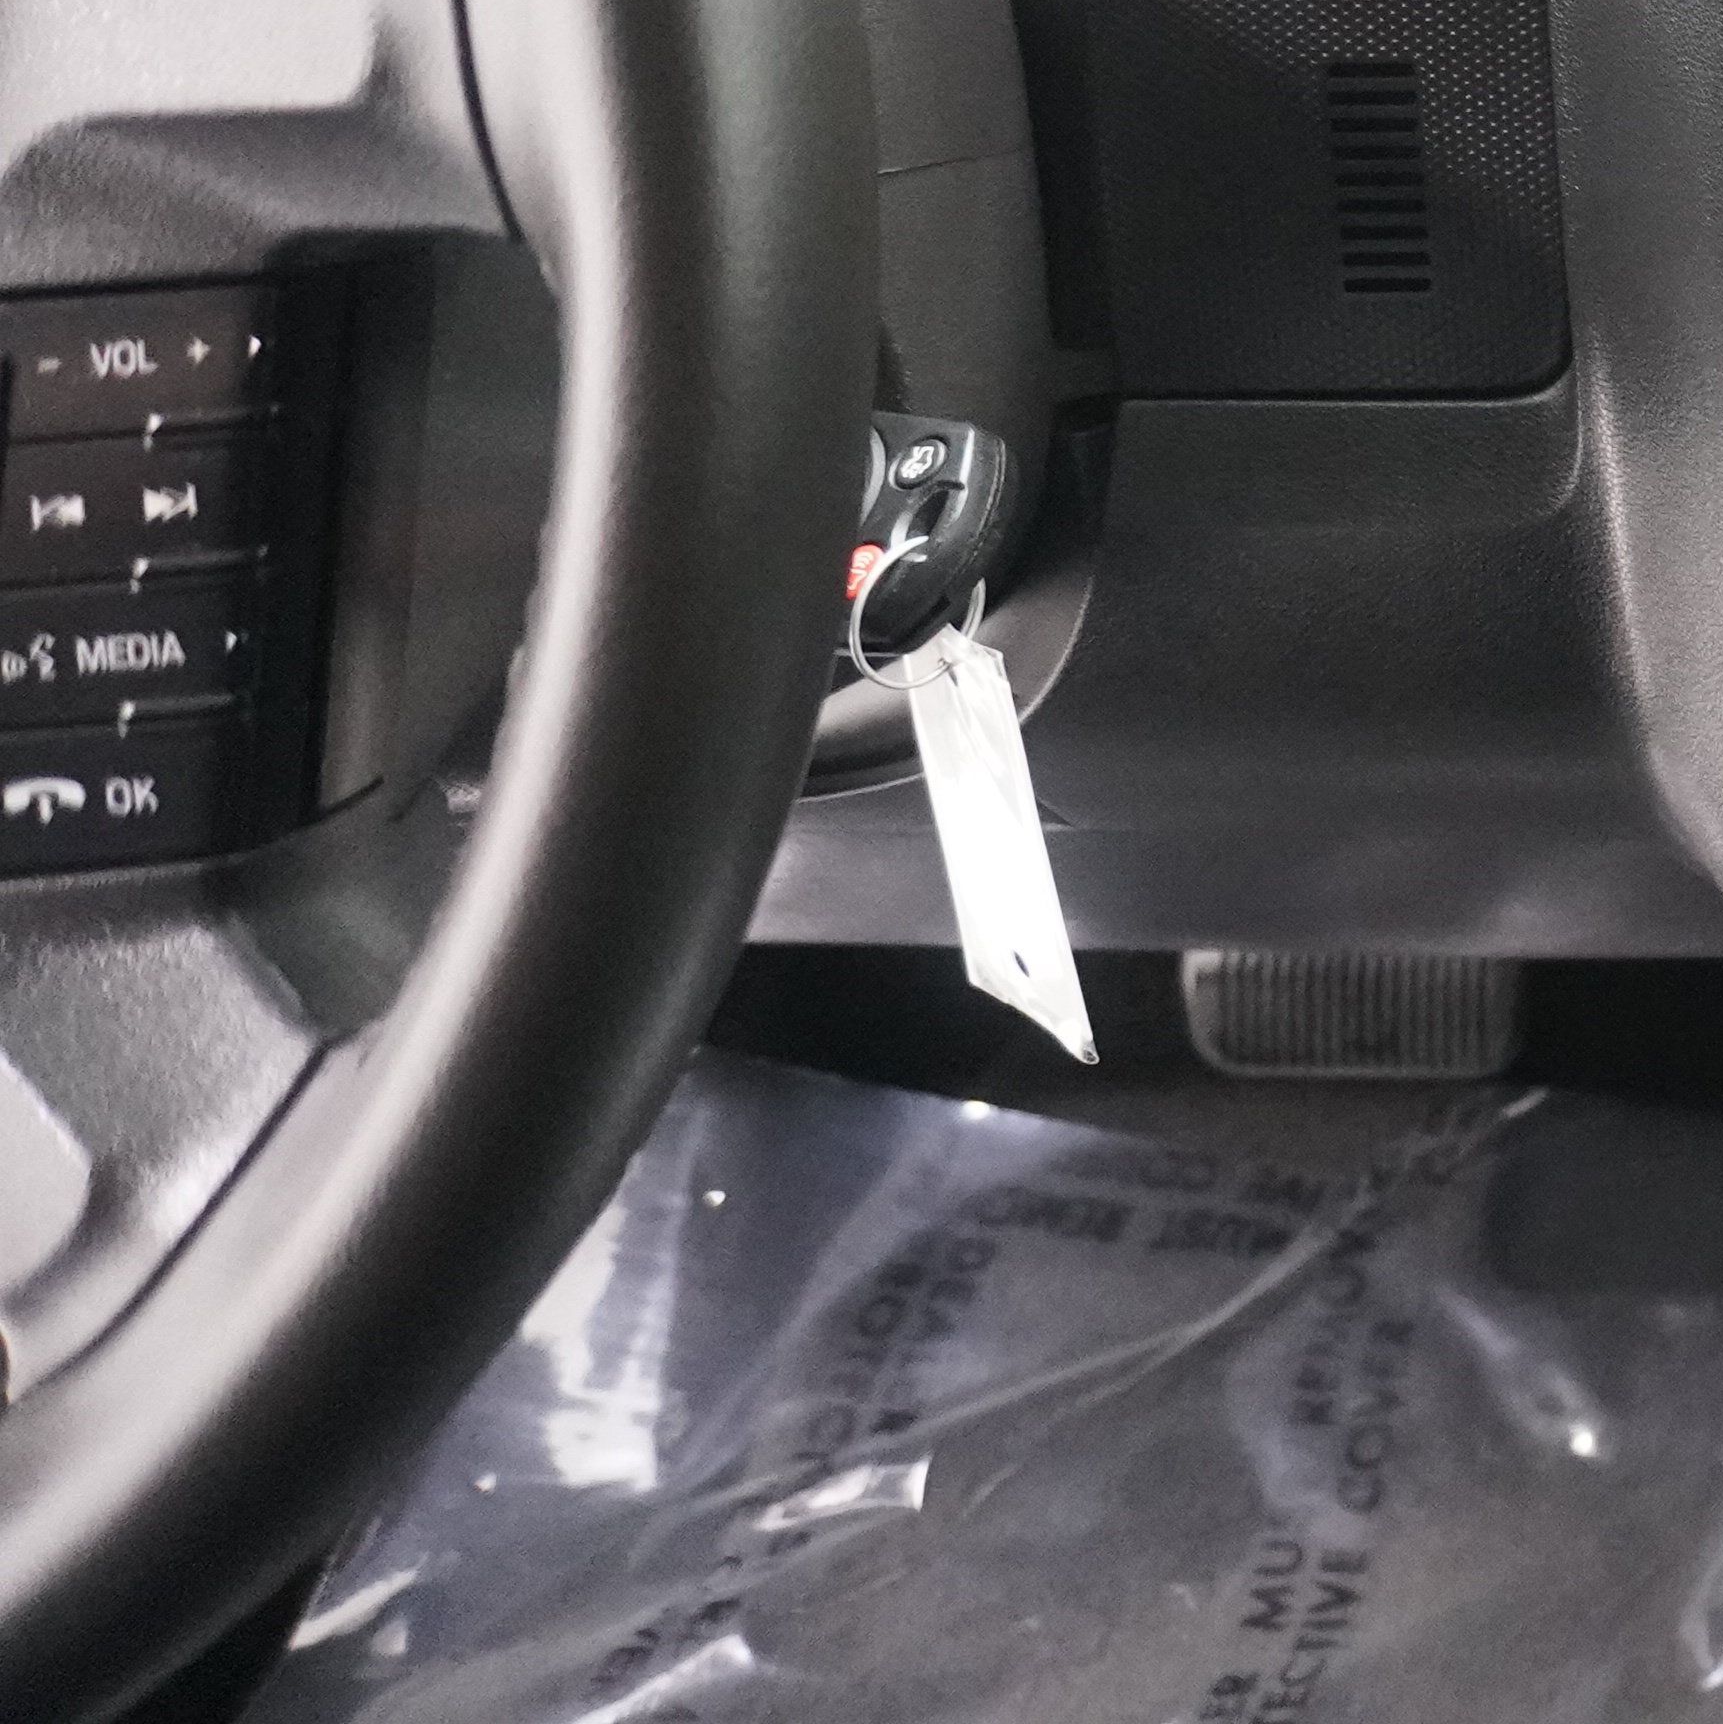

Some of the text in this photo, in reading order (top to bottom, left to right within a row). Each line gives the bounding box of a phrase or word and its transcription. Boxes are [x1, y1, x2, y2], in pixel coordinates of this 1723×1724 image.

[90, 338, 159, 378] VOL
[75, 630, 187, 676] MEDIA
[104, 777, 159, 818] OK
